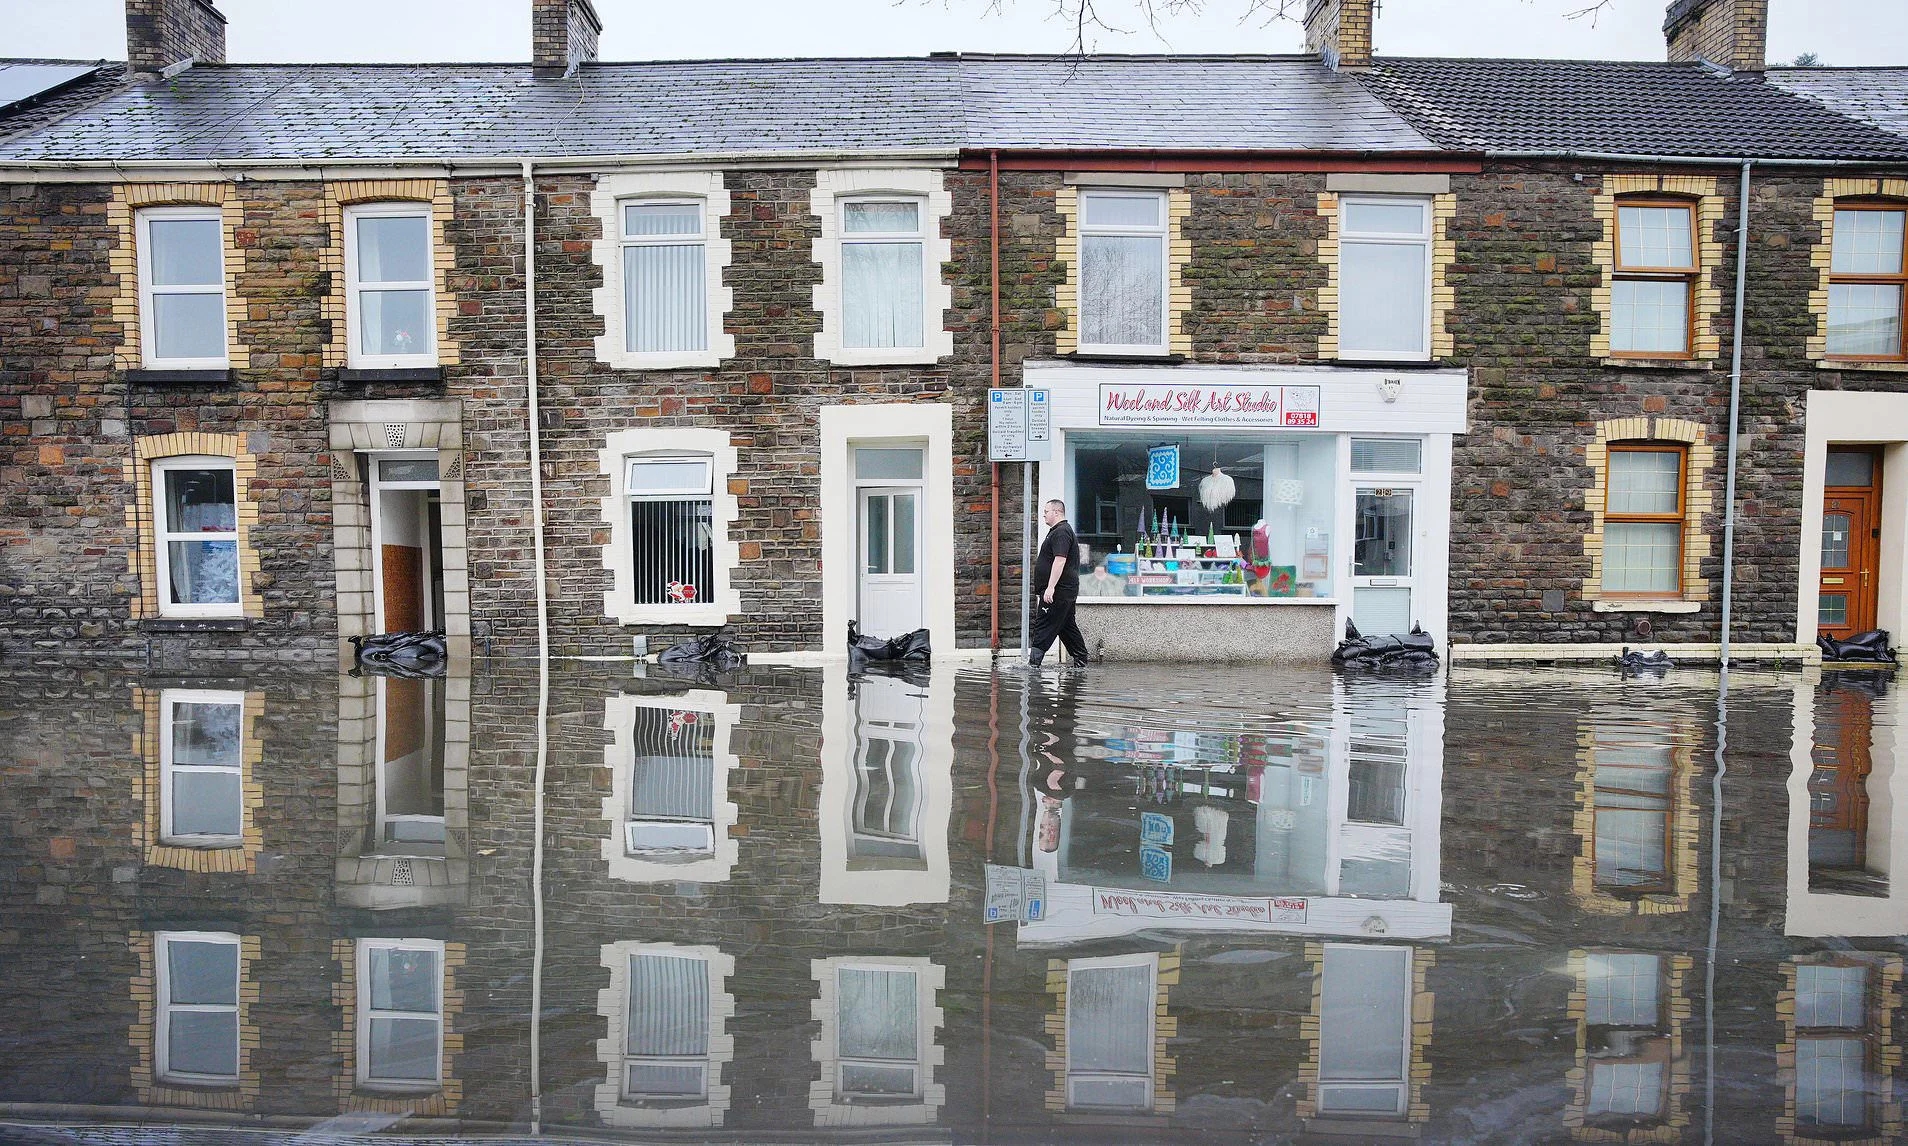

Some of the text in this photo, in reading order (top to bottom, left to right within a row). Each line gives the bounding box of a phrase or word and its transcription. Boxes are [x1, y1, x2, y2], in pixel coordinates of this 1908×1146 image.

[1107, 388, 1277, 413] Wool and Silk Art Studio
